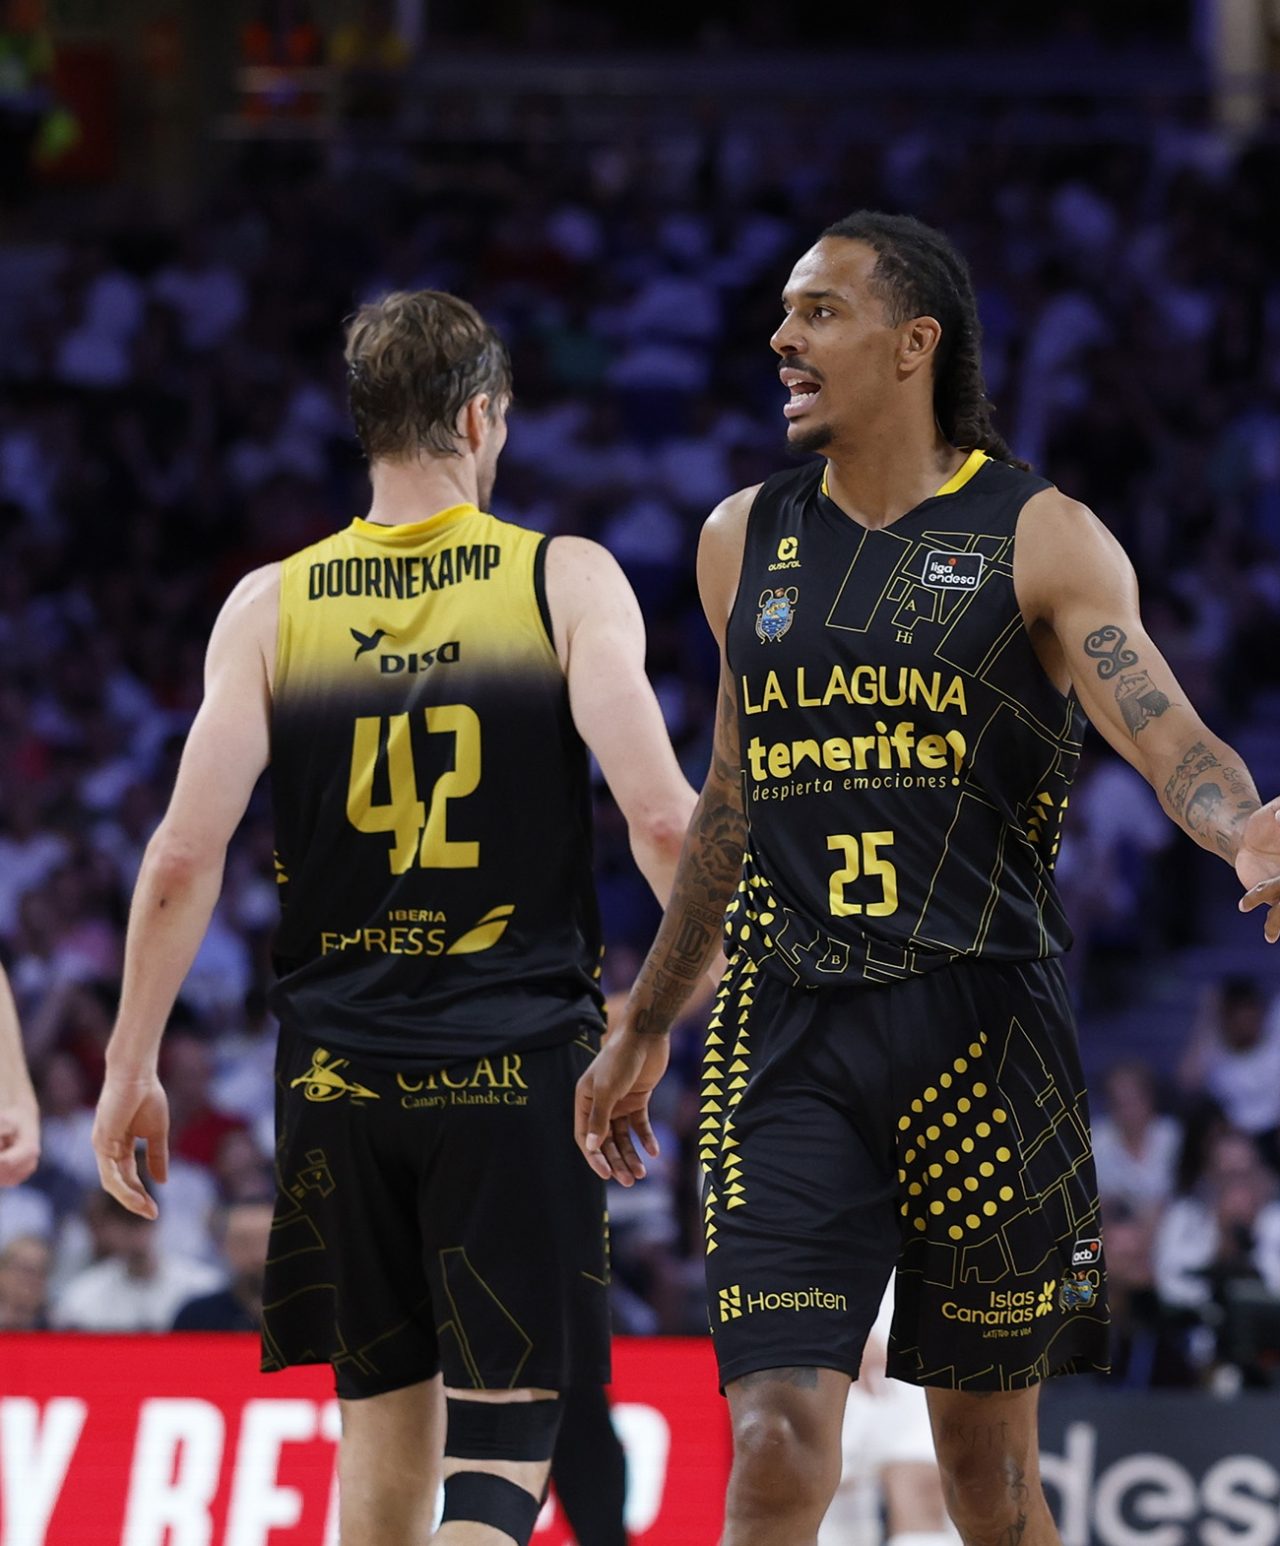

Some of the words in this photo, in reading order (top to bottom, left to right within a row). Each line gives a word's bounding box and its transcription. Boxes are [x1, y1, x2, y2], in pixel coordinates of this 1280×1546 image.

[308, 544, 501, 600] DOORNEKAMP
[928, 573, 975, 585] endesa
[931, 562, 953, 575] liga
[905, 599, 916, 611] A
[895, 630, 913, 644] Hi
[742, 670, 788, 715] LA
[797, 665, 967, 715] LAGUNA
[346, 704, 481, 875] 42
[753, 777, 833, 801] despierta
[843, 773, 946, 789] emociones
[827, 831, 898, 917] 25
[389, 910, 446, 922] IBERIA
[321, 928, 446, 956] EXRESS
[401, 1094, 446, 1109] Canary
[451, 1090, 500, 1105] Islands
[503, 1091, 528, 1105] Car
[1073, 1248, 1093, 1261] acb
[747, 1286, 847, 1314] Hospiten
[990, 1290, 1035, 1309] Islas
[941, 1302, 1034, 1325] Canarias
